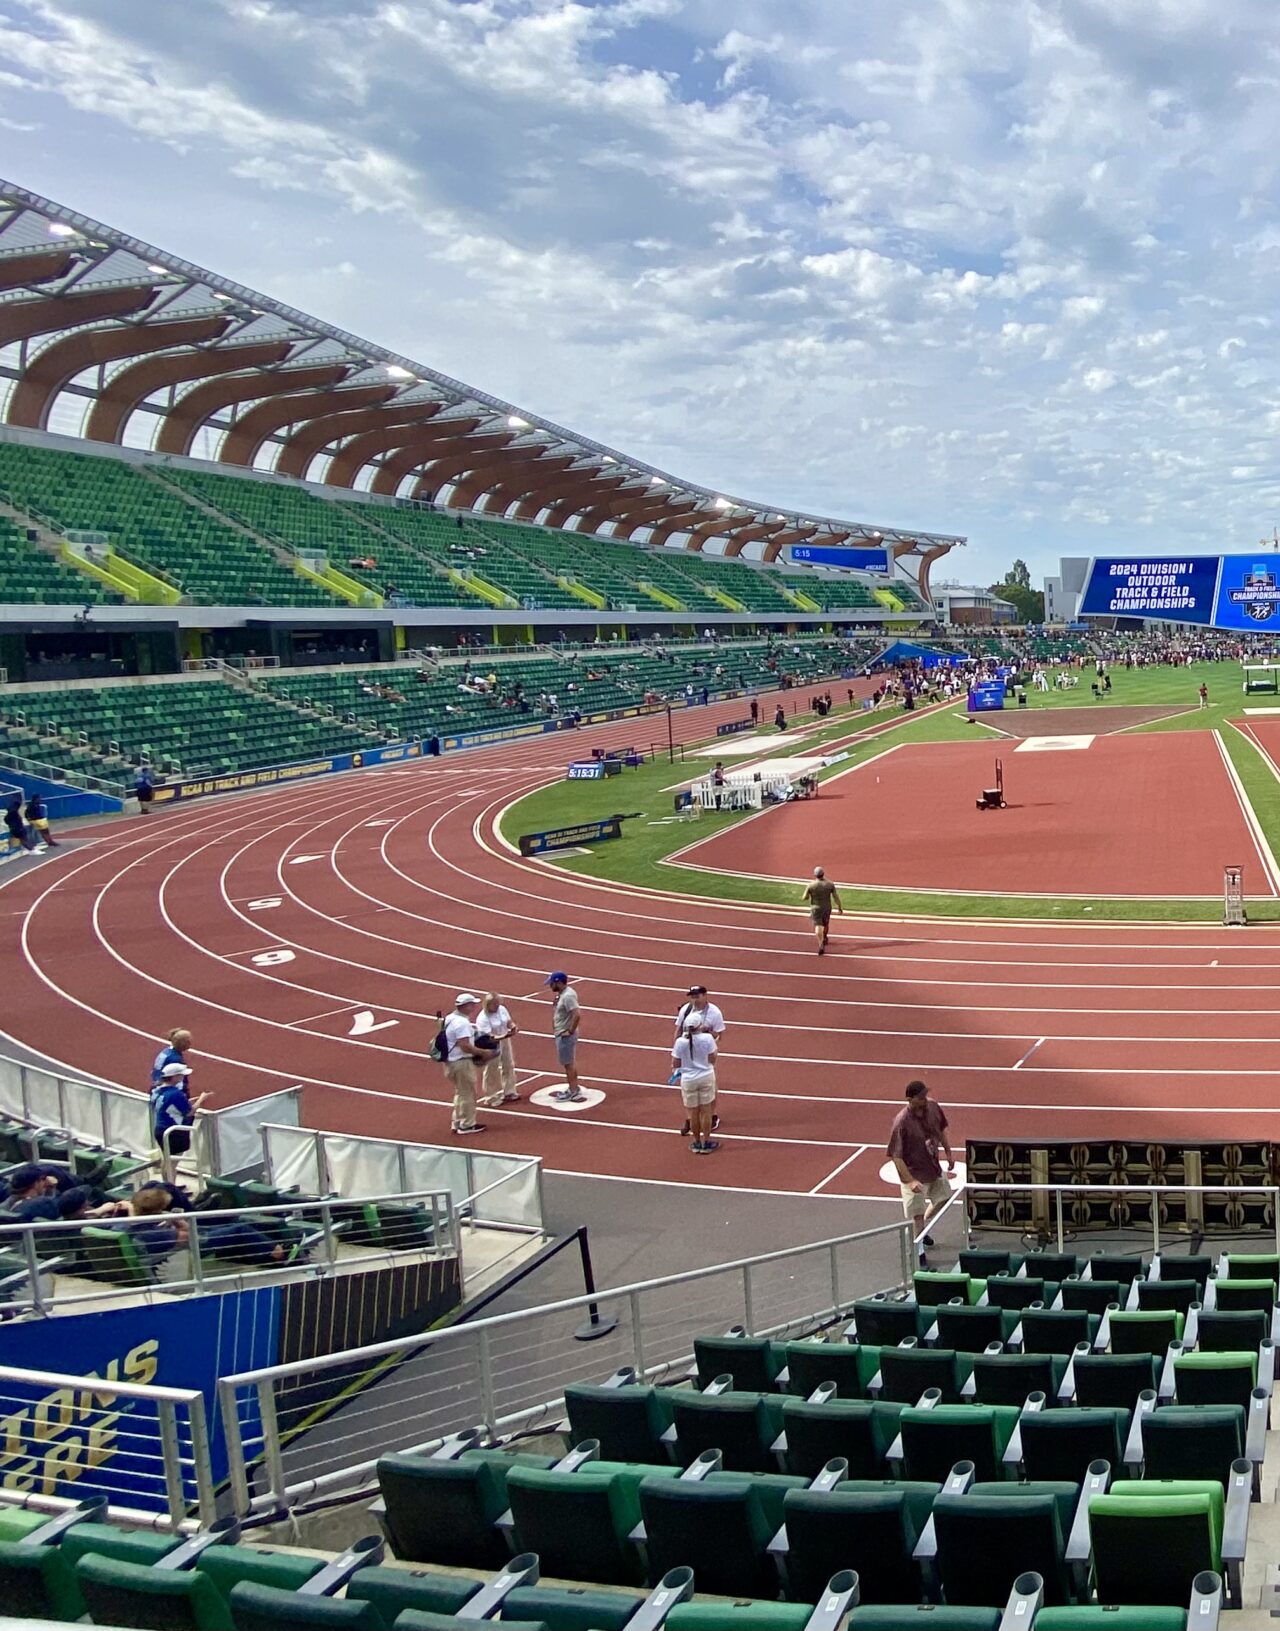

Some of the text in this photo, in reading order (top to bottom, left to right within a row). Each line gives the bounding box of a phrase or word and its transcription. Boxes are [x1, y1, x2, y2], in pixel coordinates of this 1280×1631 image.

[794, 549, 811, 558] 5:15
[1109, 563, 1193, 576] 2024 DIVISION I
[1127, 575, 1176, 587] OUTDOOR
[1115, 586, 1190, 598] TRACK & FIELD
[1109, 597, 1196, 610] CHAMPIONSHIPS
[568, 768, 600, 778] 5:15:31
